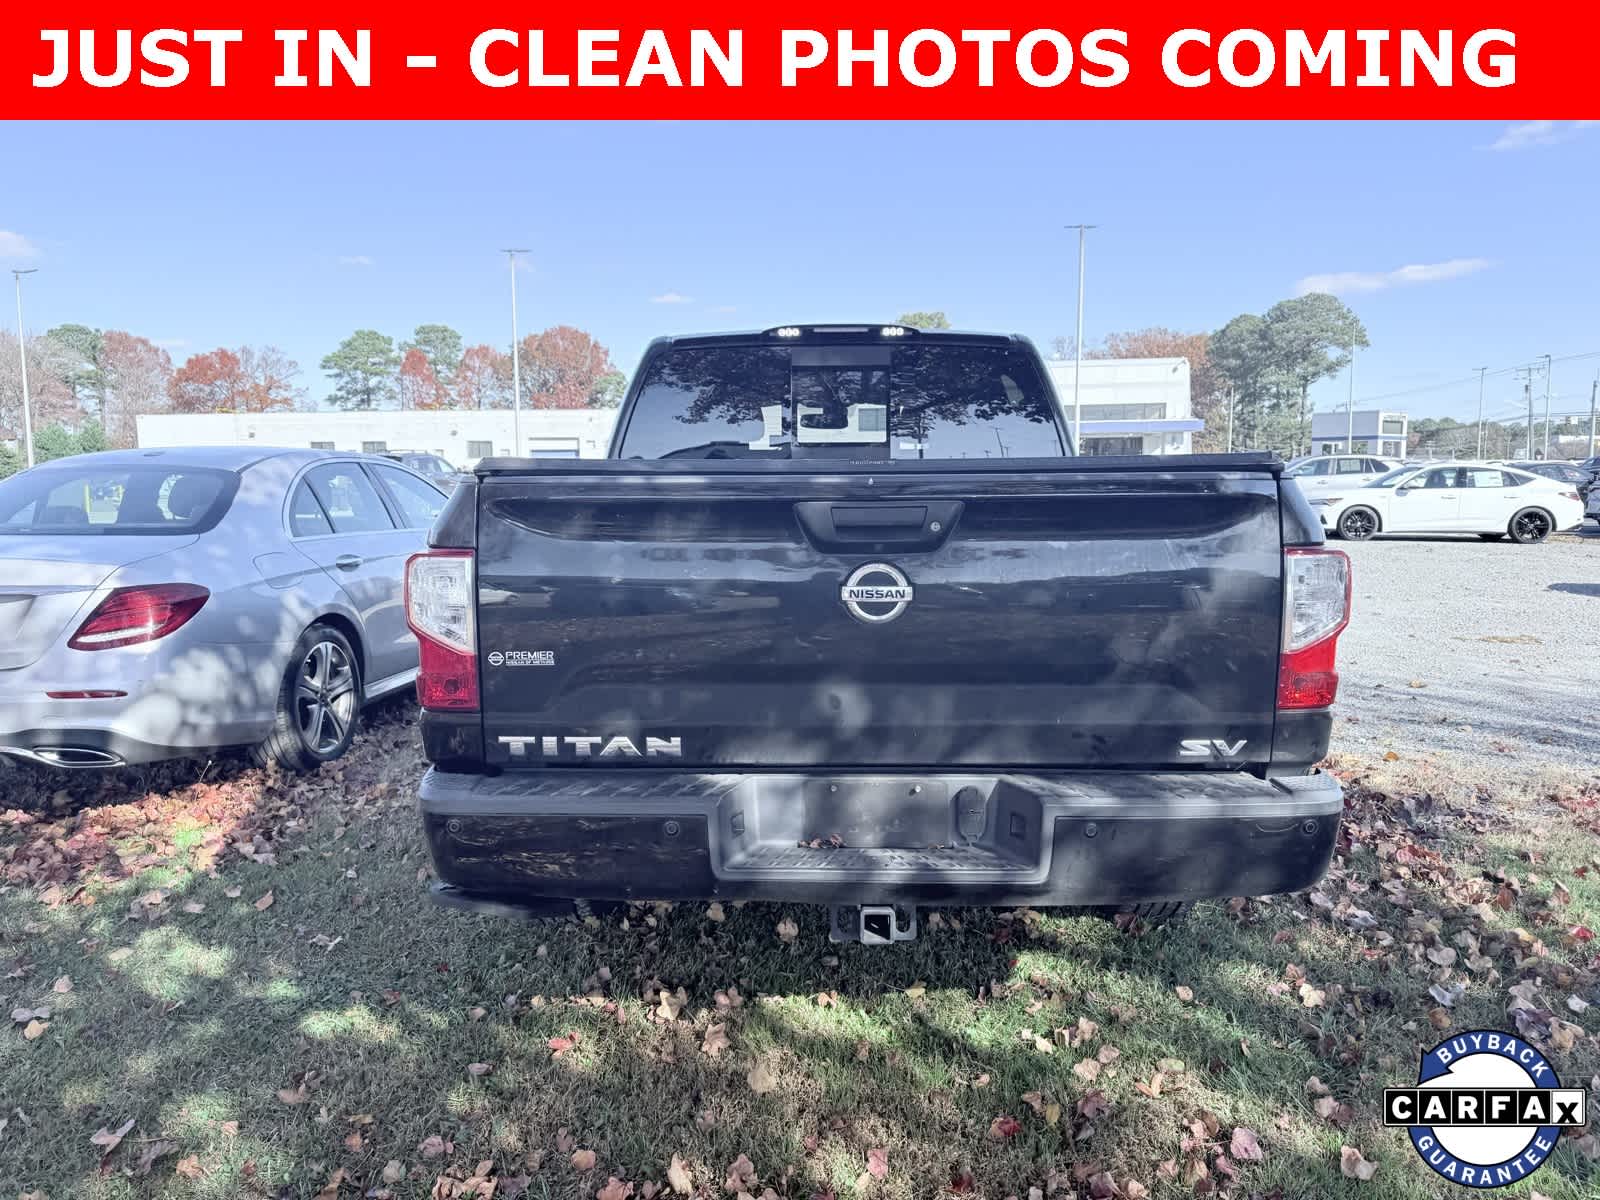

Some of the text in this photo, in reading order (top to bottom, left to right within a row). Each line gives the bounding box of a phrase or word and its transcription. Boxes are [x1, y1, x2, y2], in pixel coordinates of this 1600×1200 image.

[849, 589, 906, 599] NISSAN
[505, 650, 555, 660] PREMIER
[498, 736, 682, 757] TITAN
[1180, 739, 1248, 756] SV
